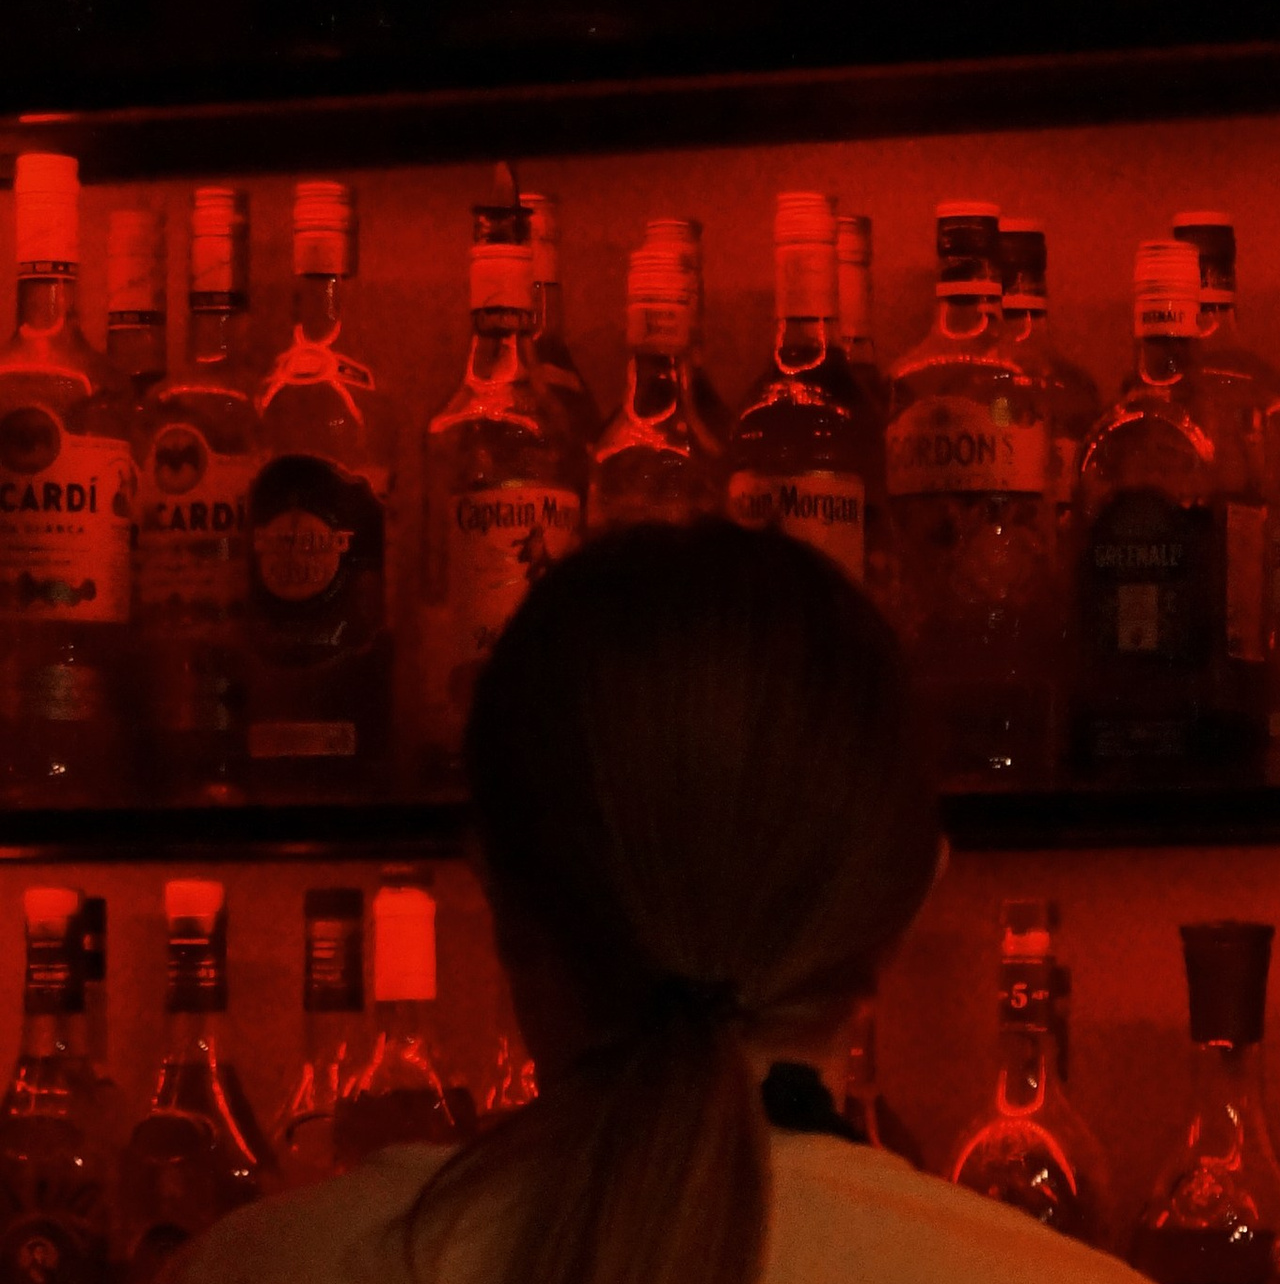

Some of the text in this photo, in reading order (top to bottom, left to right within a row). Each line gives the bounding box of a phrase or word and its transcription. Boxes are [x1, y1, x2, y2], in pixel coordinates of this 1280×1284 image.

[0, 476, 98, 514] CARDÍ
[779, 485, 859, 526] Morgan
[456, 496, 536, 537] Captain
[1010, 982, 1028, 1009] 5
